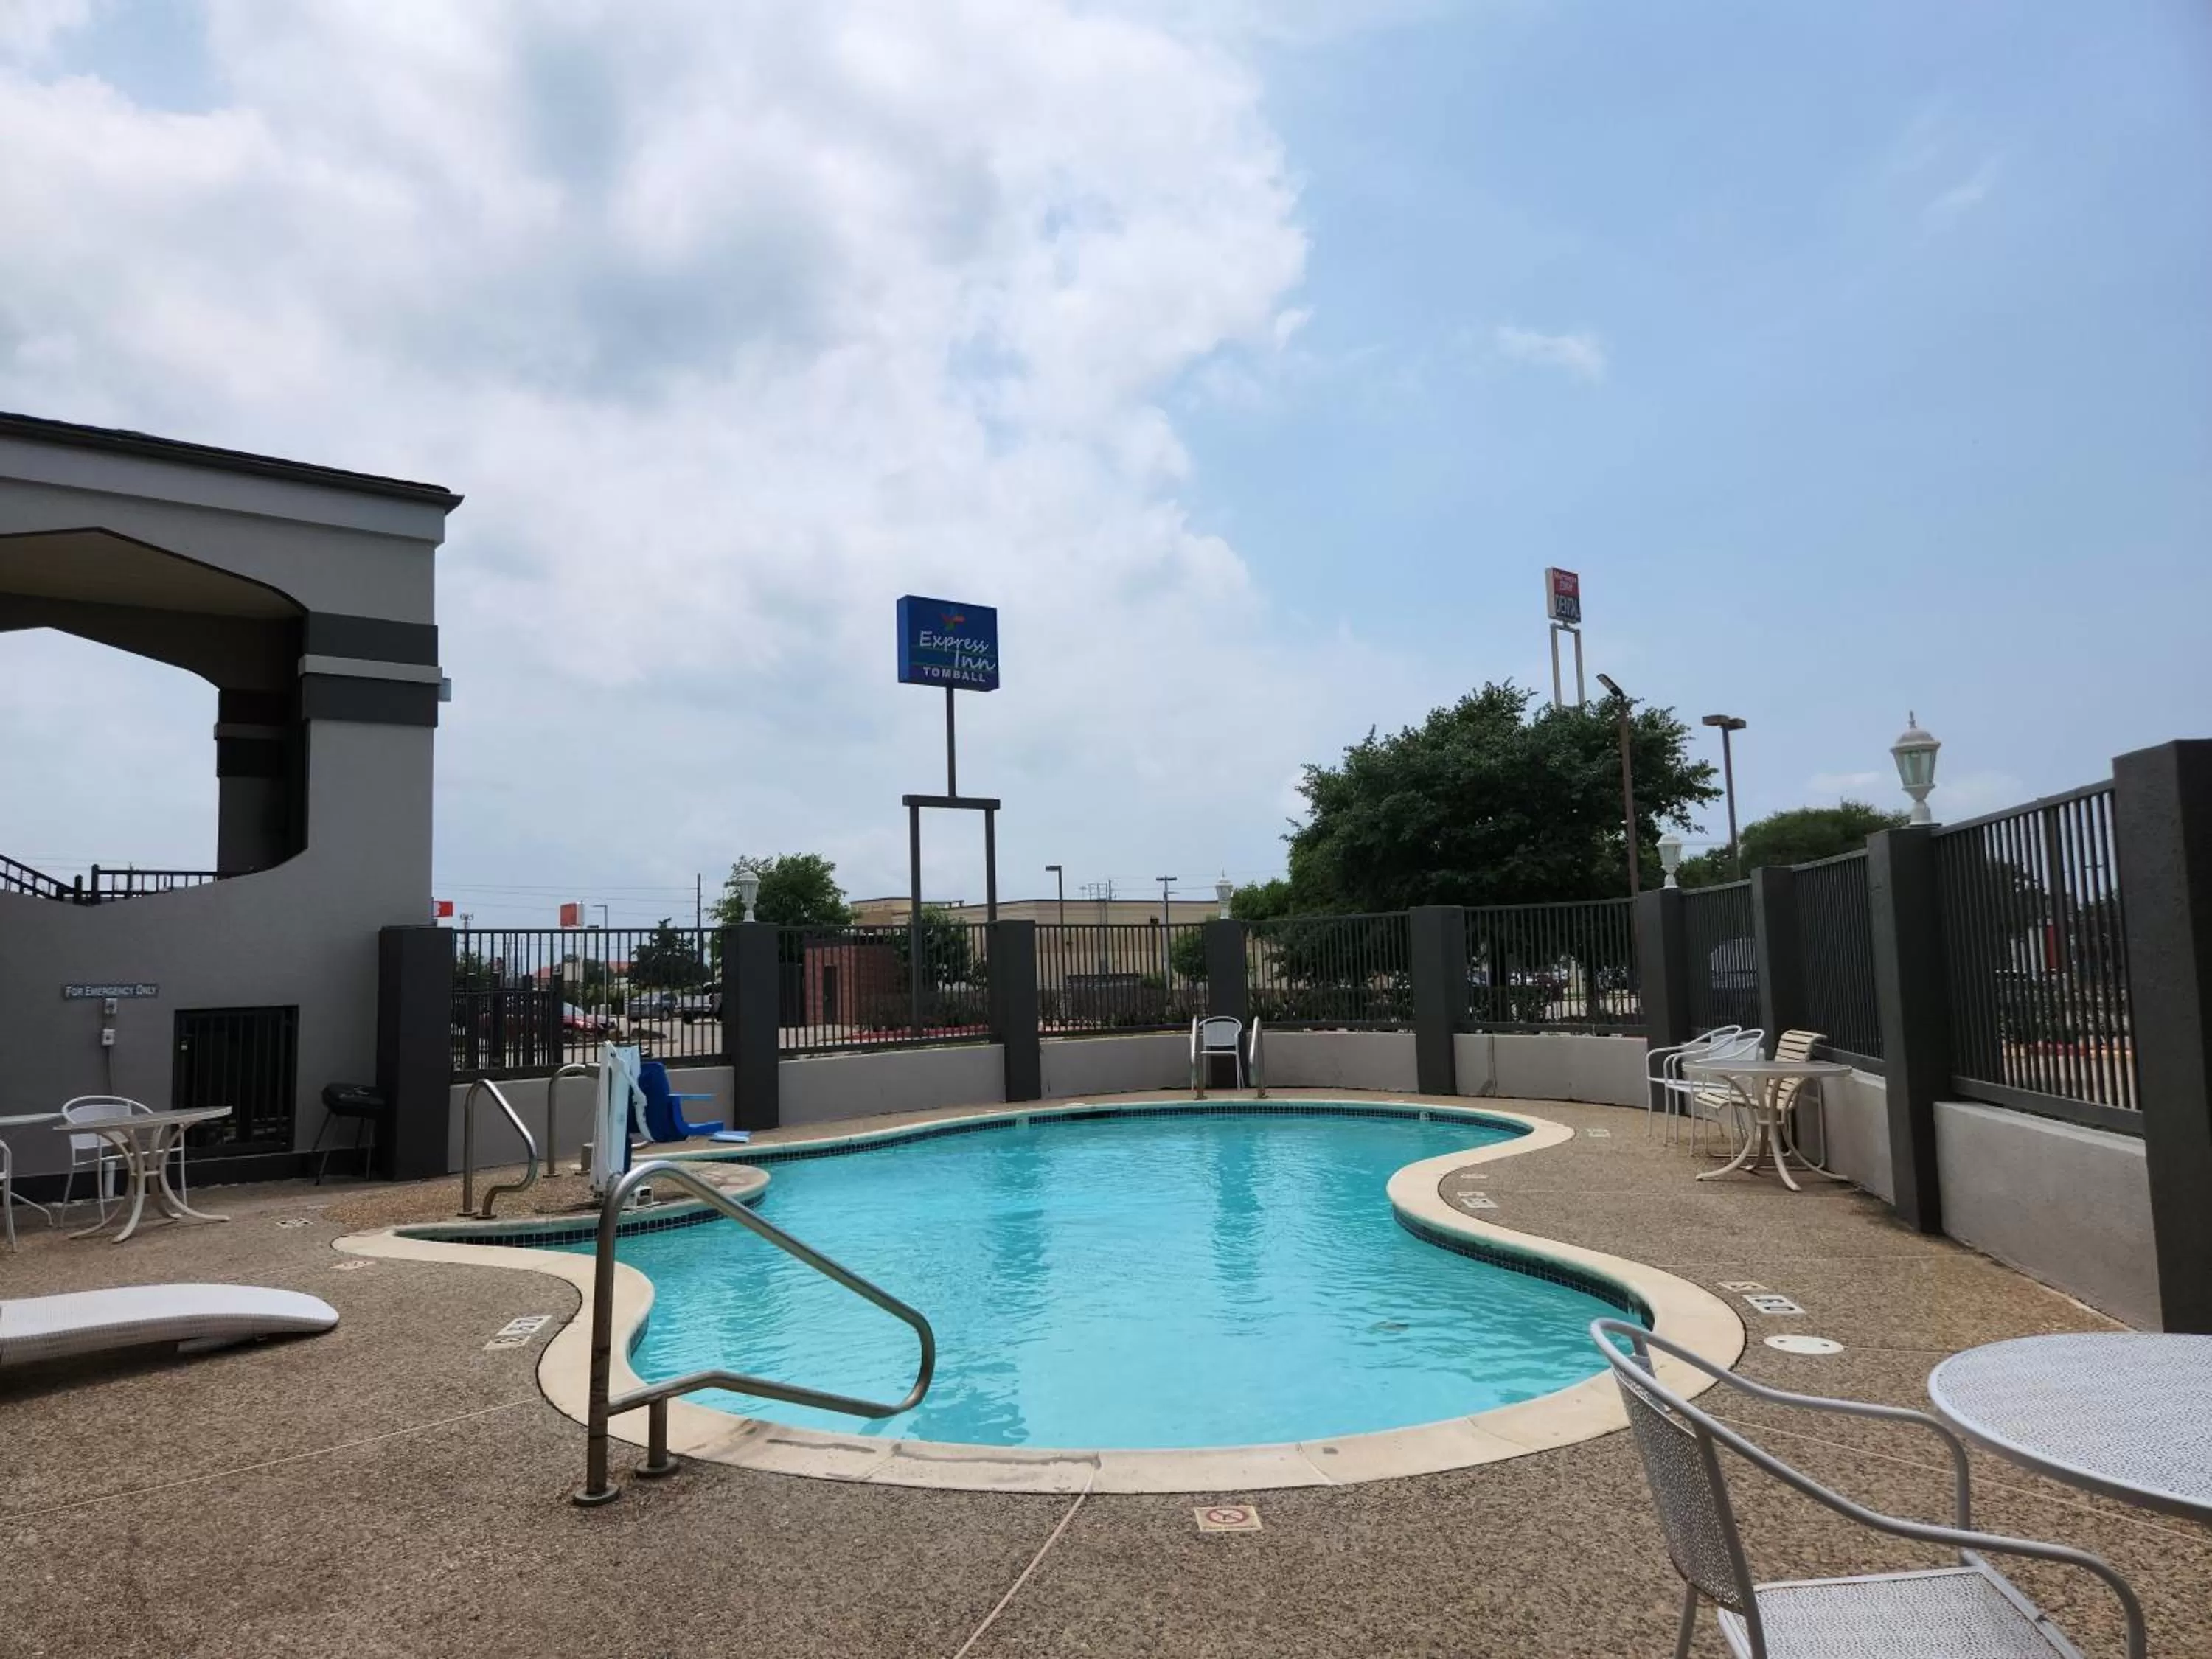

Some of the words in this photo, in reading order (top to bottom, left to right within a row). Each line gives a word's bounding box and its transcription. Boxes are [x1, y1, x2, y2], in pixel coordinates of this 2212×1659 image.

[919, 630, 989, 653] Express
[954, 649, 996, 670] Inn
[922, 666, 986, 682] TOMBALL
